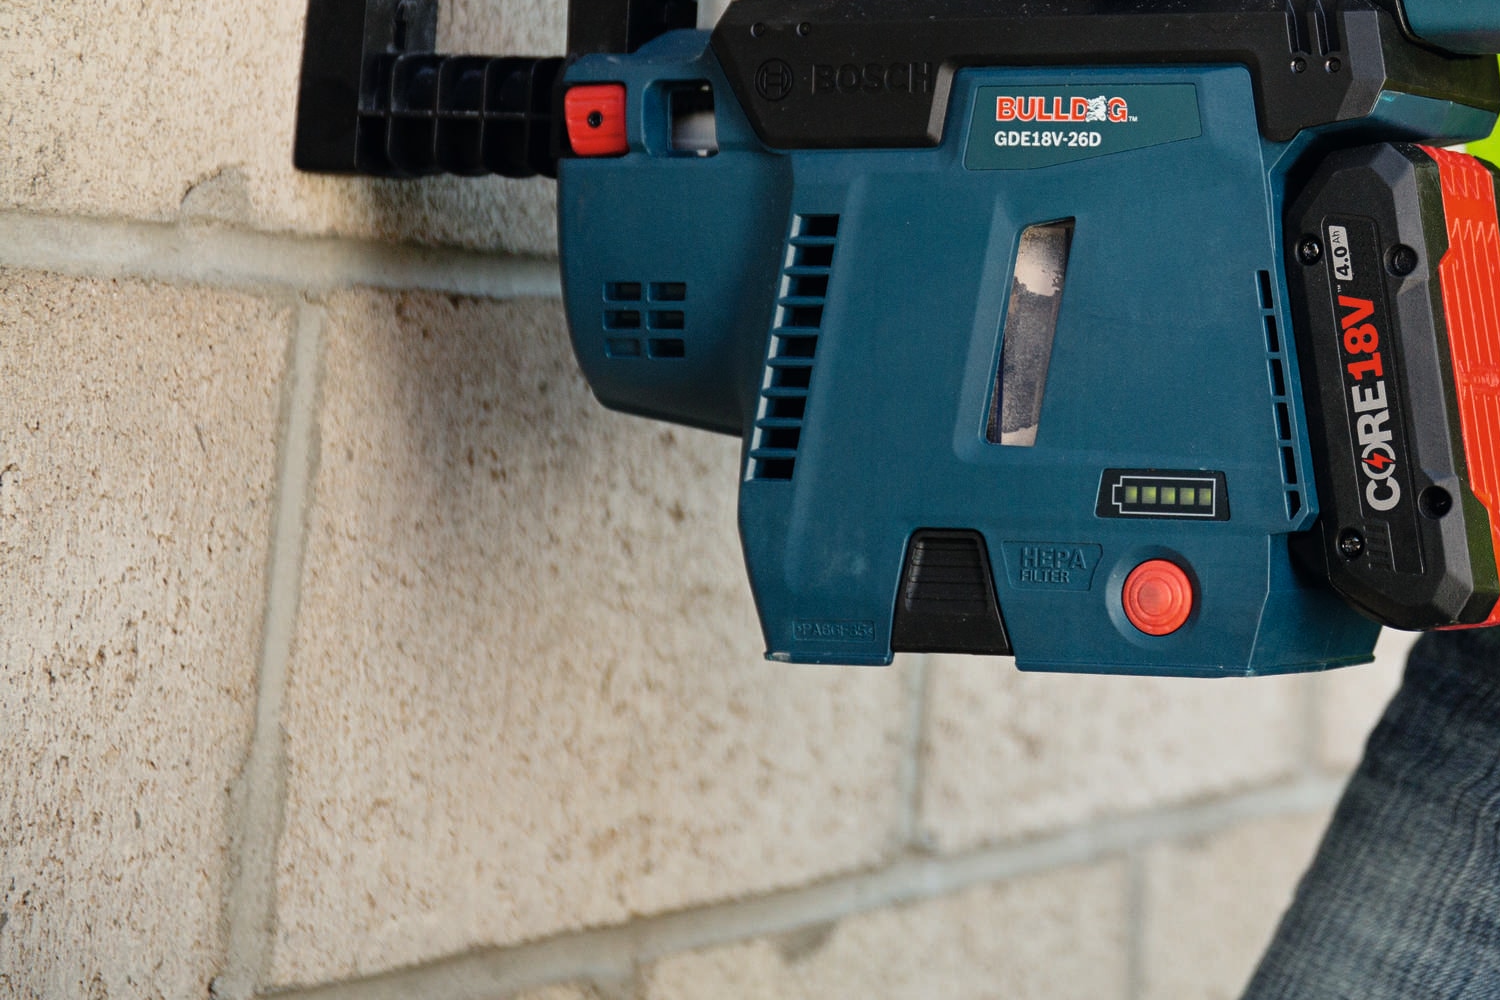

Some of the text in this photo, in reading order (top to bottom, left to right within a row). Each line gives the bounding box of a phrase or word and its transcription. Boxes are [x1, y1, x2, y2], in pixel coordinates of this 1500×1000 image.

[811, 62, 933, 96] BOSCH
[994, 131, 1102, 147] GDE18V-26D
[1331, 230, 1350, 276] 4.0 Ah
[1020, 547, 1087, 569] HEPA
[1020, 569, 1070, 583] FILTER
